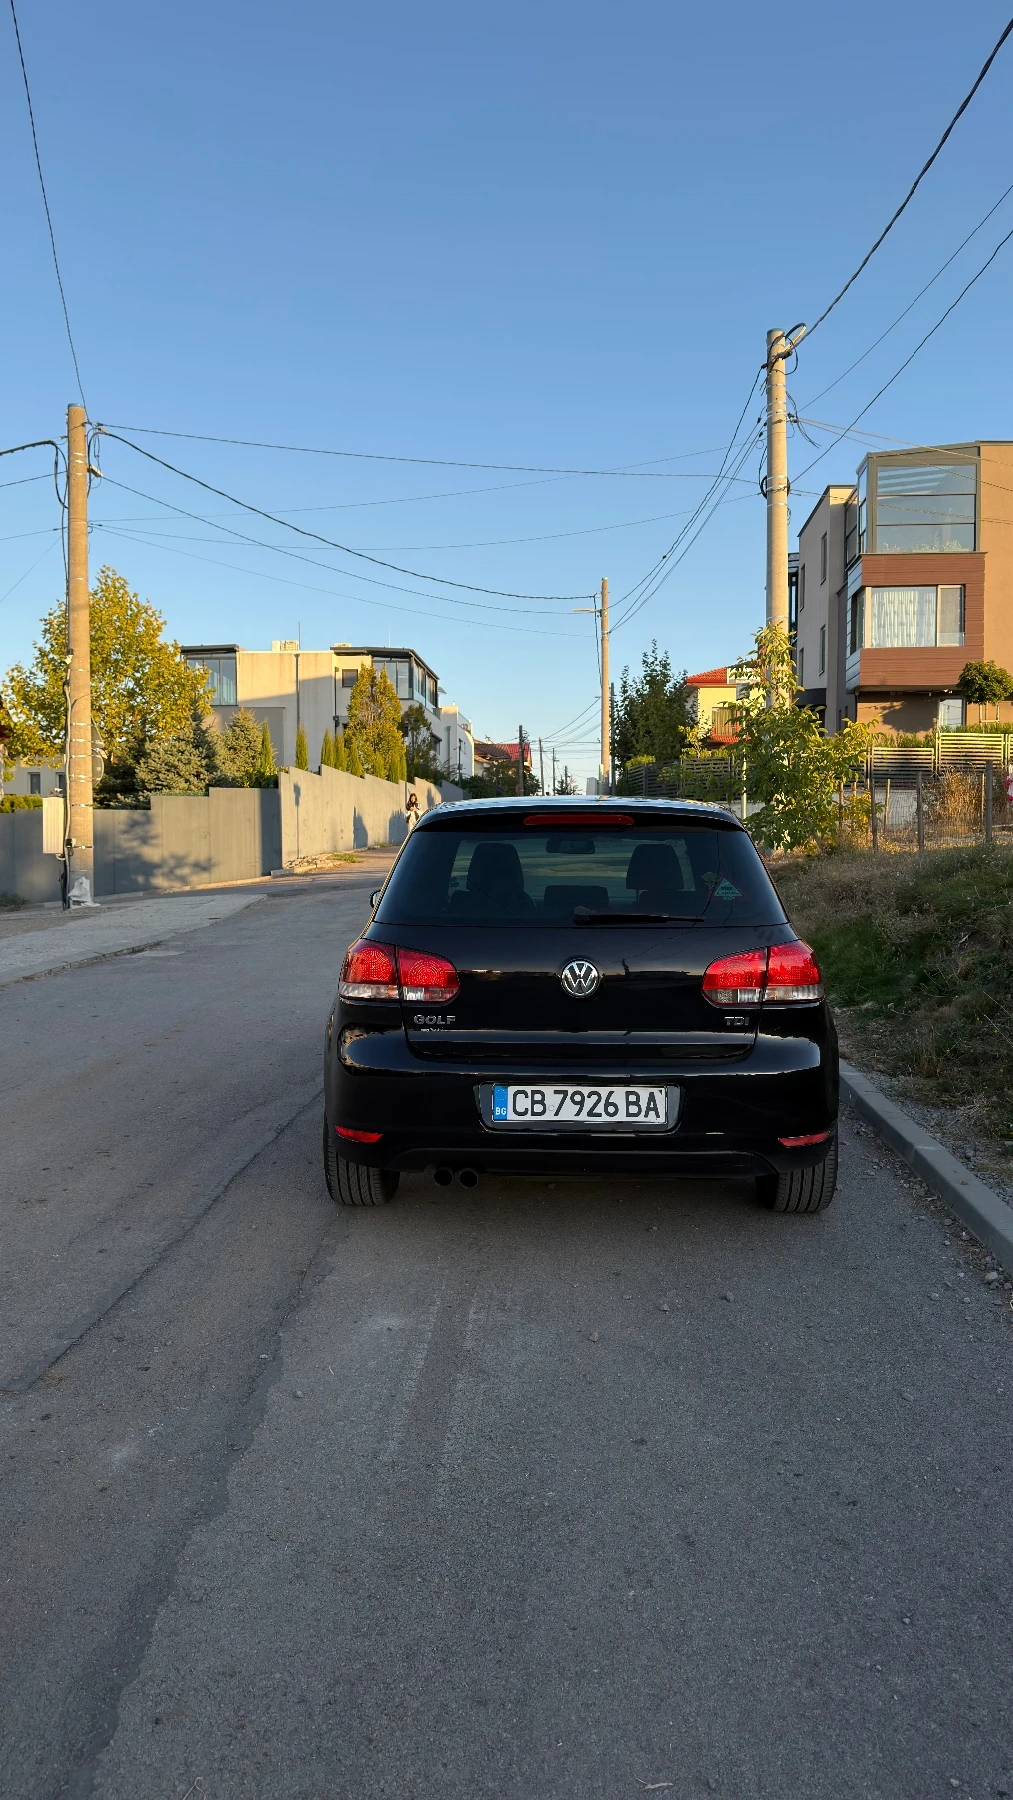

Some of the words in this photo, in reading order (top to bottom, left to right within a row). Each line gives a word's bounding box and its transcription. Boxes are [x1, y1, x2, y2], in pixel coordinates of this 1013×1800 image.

[413, 1014, 456, 1025] GOLF
[724, 1016, 750, 1026] TDI
[495, 1106, 507, 1116] BG
